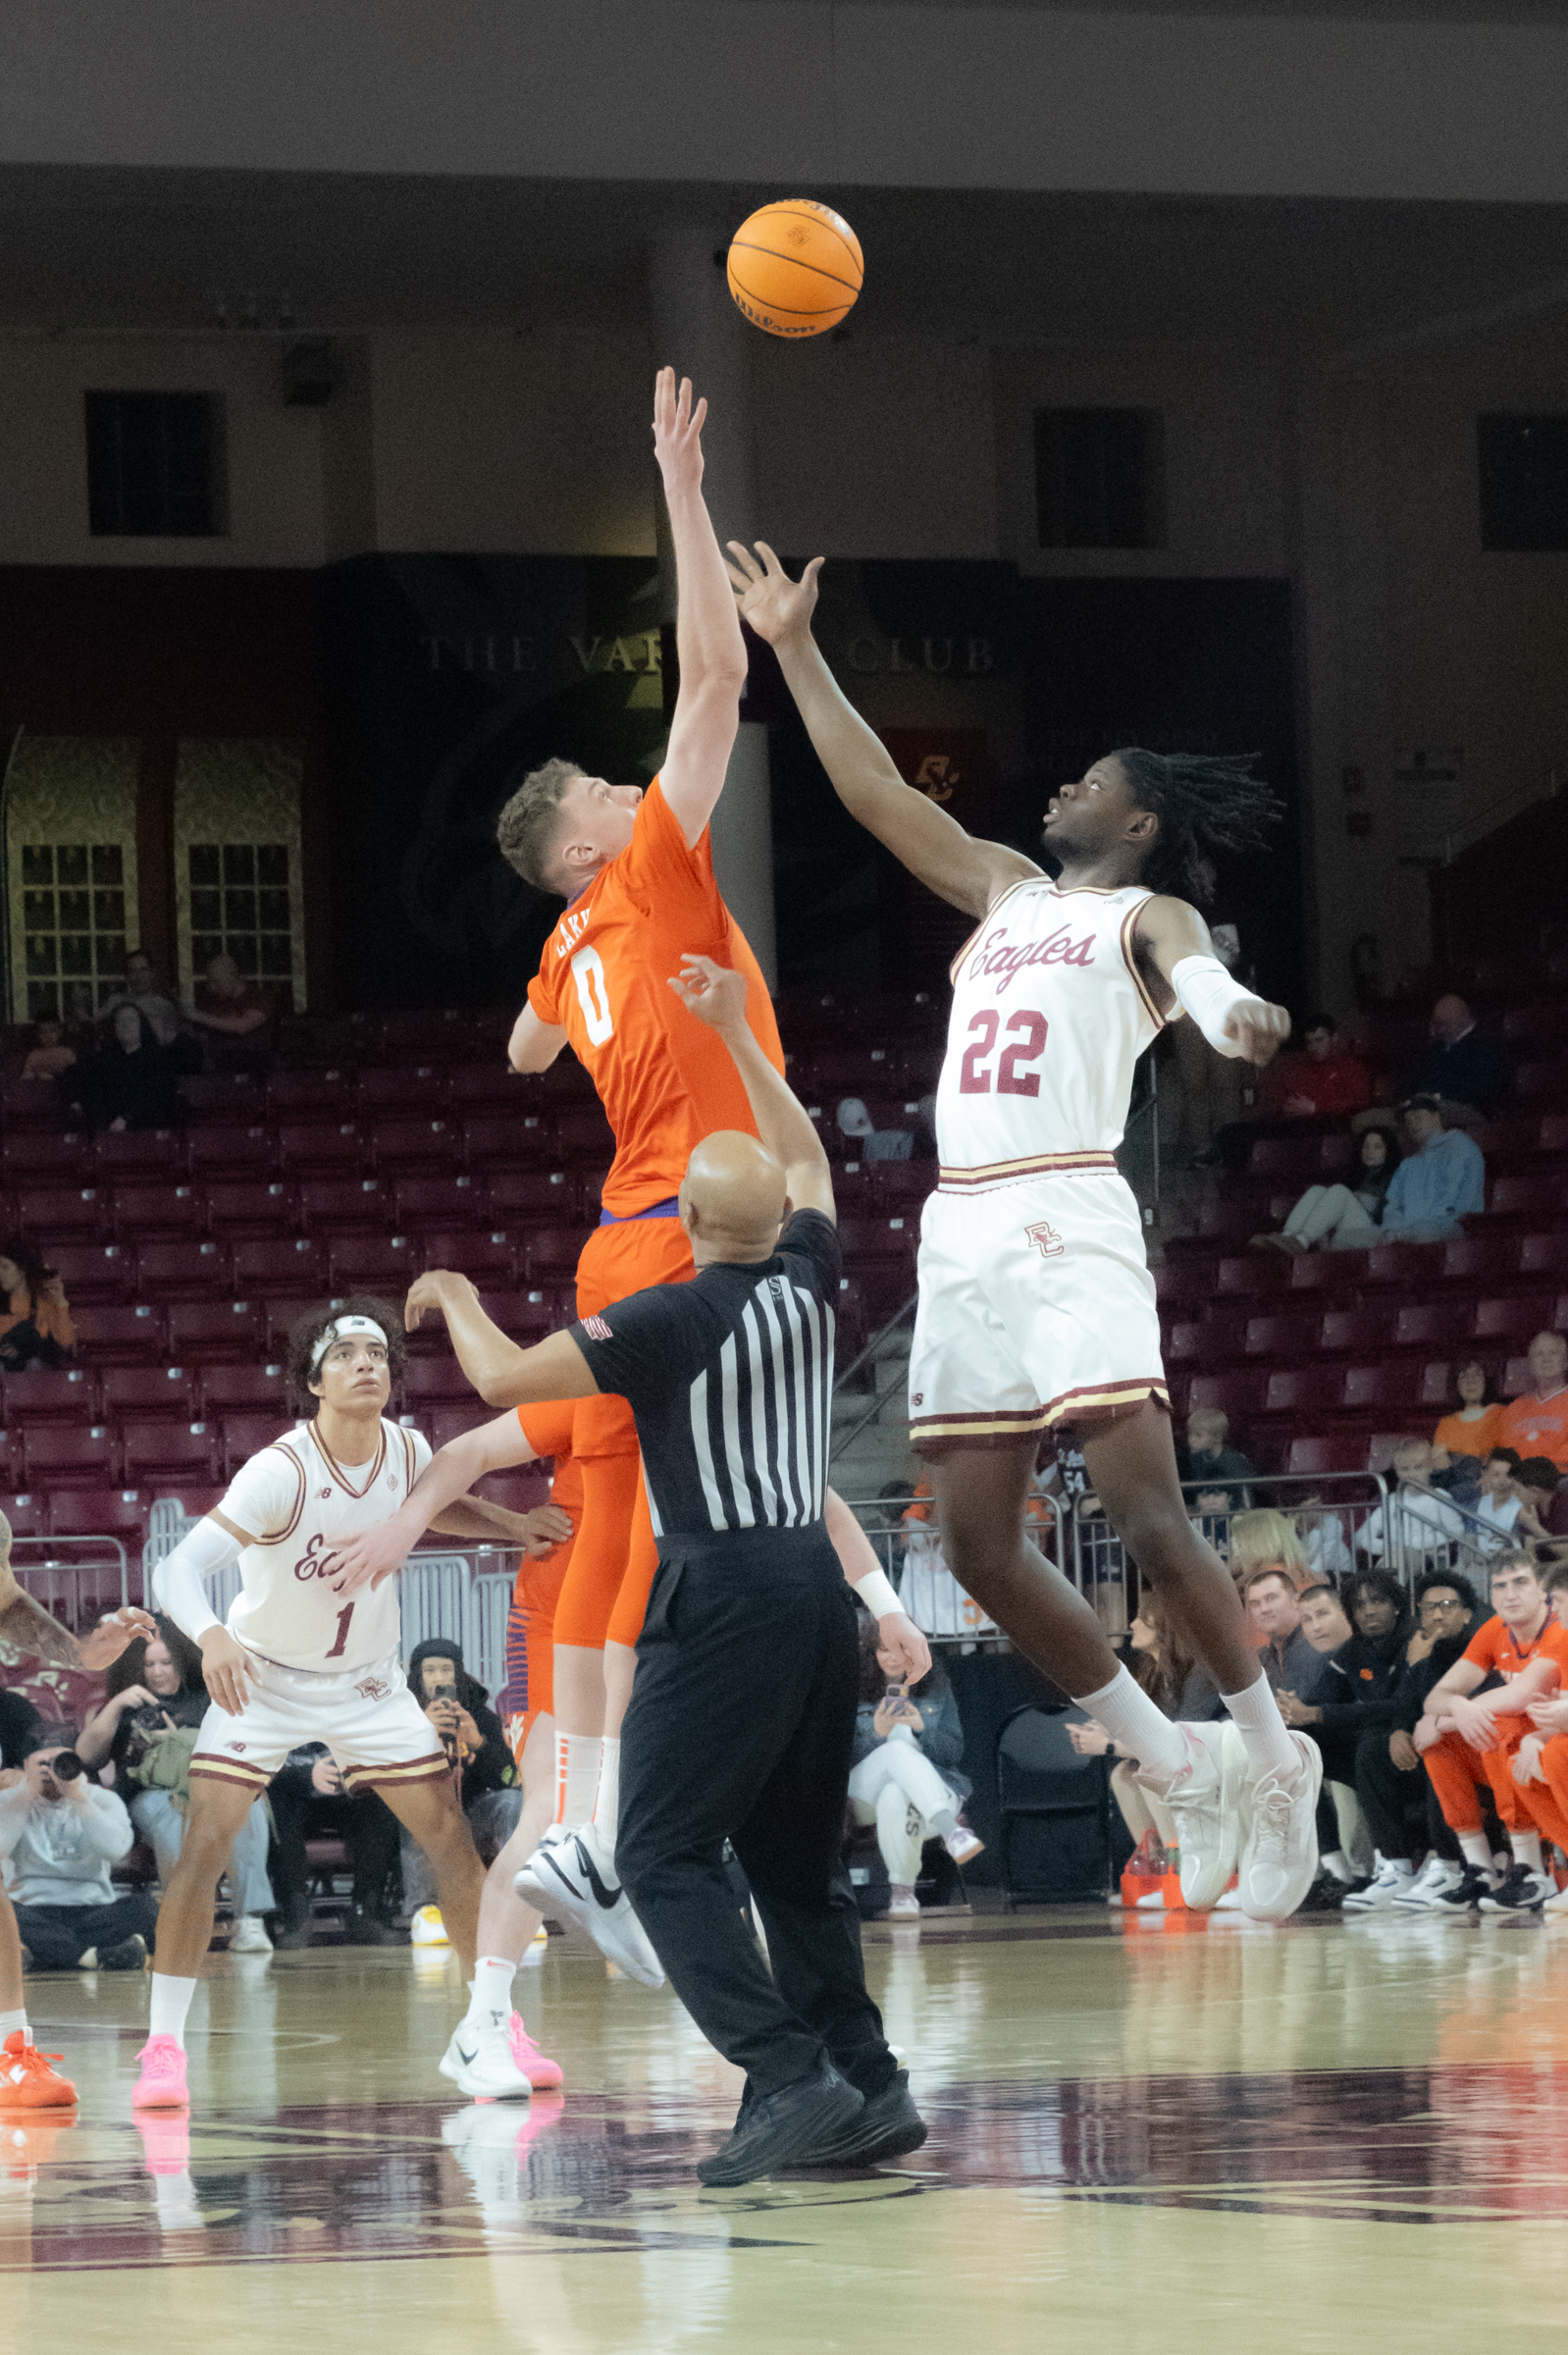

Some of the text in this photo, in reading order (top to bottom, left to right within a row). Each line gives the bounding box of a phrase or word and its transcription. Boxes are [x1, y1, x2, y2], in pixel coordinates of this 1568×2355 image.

[734, 292, 815, 334] Wilson
[420, 636, 537, 671] THE
[847, 637, 993, 673] CLUB
[968, 923, 1097, 995] Eagles
[571, 944, 613, 1047] 0
[959, 1009, 1049, 1097] 22
[325, 1601, 355, 1658] 1
